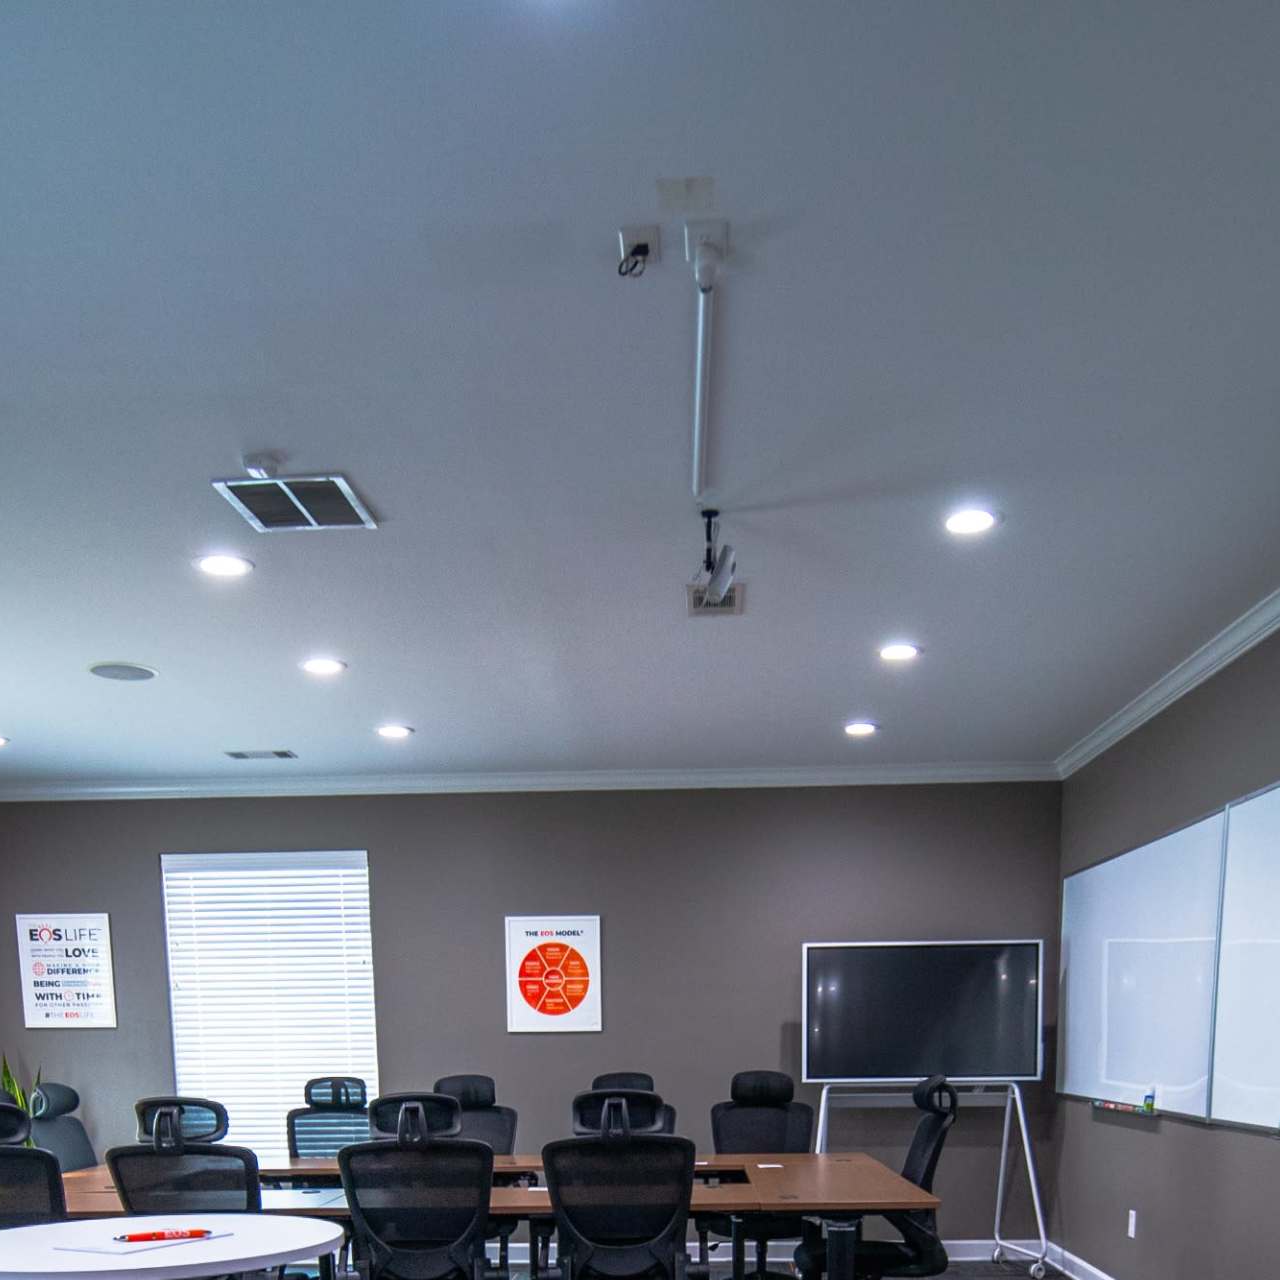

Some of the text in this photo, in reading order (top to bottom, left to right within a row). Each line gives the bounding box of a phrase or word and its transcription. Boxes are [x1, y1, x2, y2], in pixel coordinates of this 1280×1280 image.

[29, 928, 98, 943] EOS LIFE
[65, 947, 99, 958] LOVE
[35, 992, 101, 1001] WITH TIM
